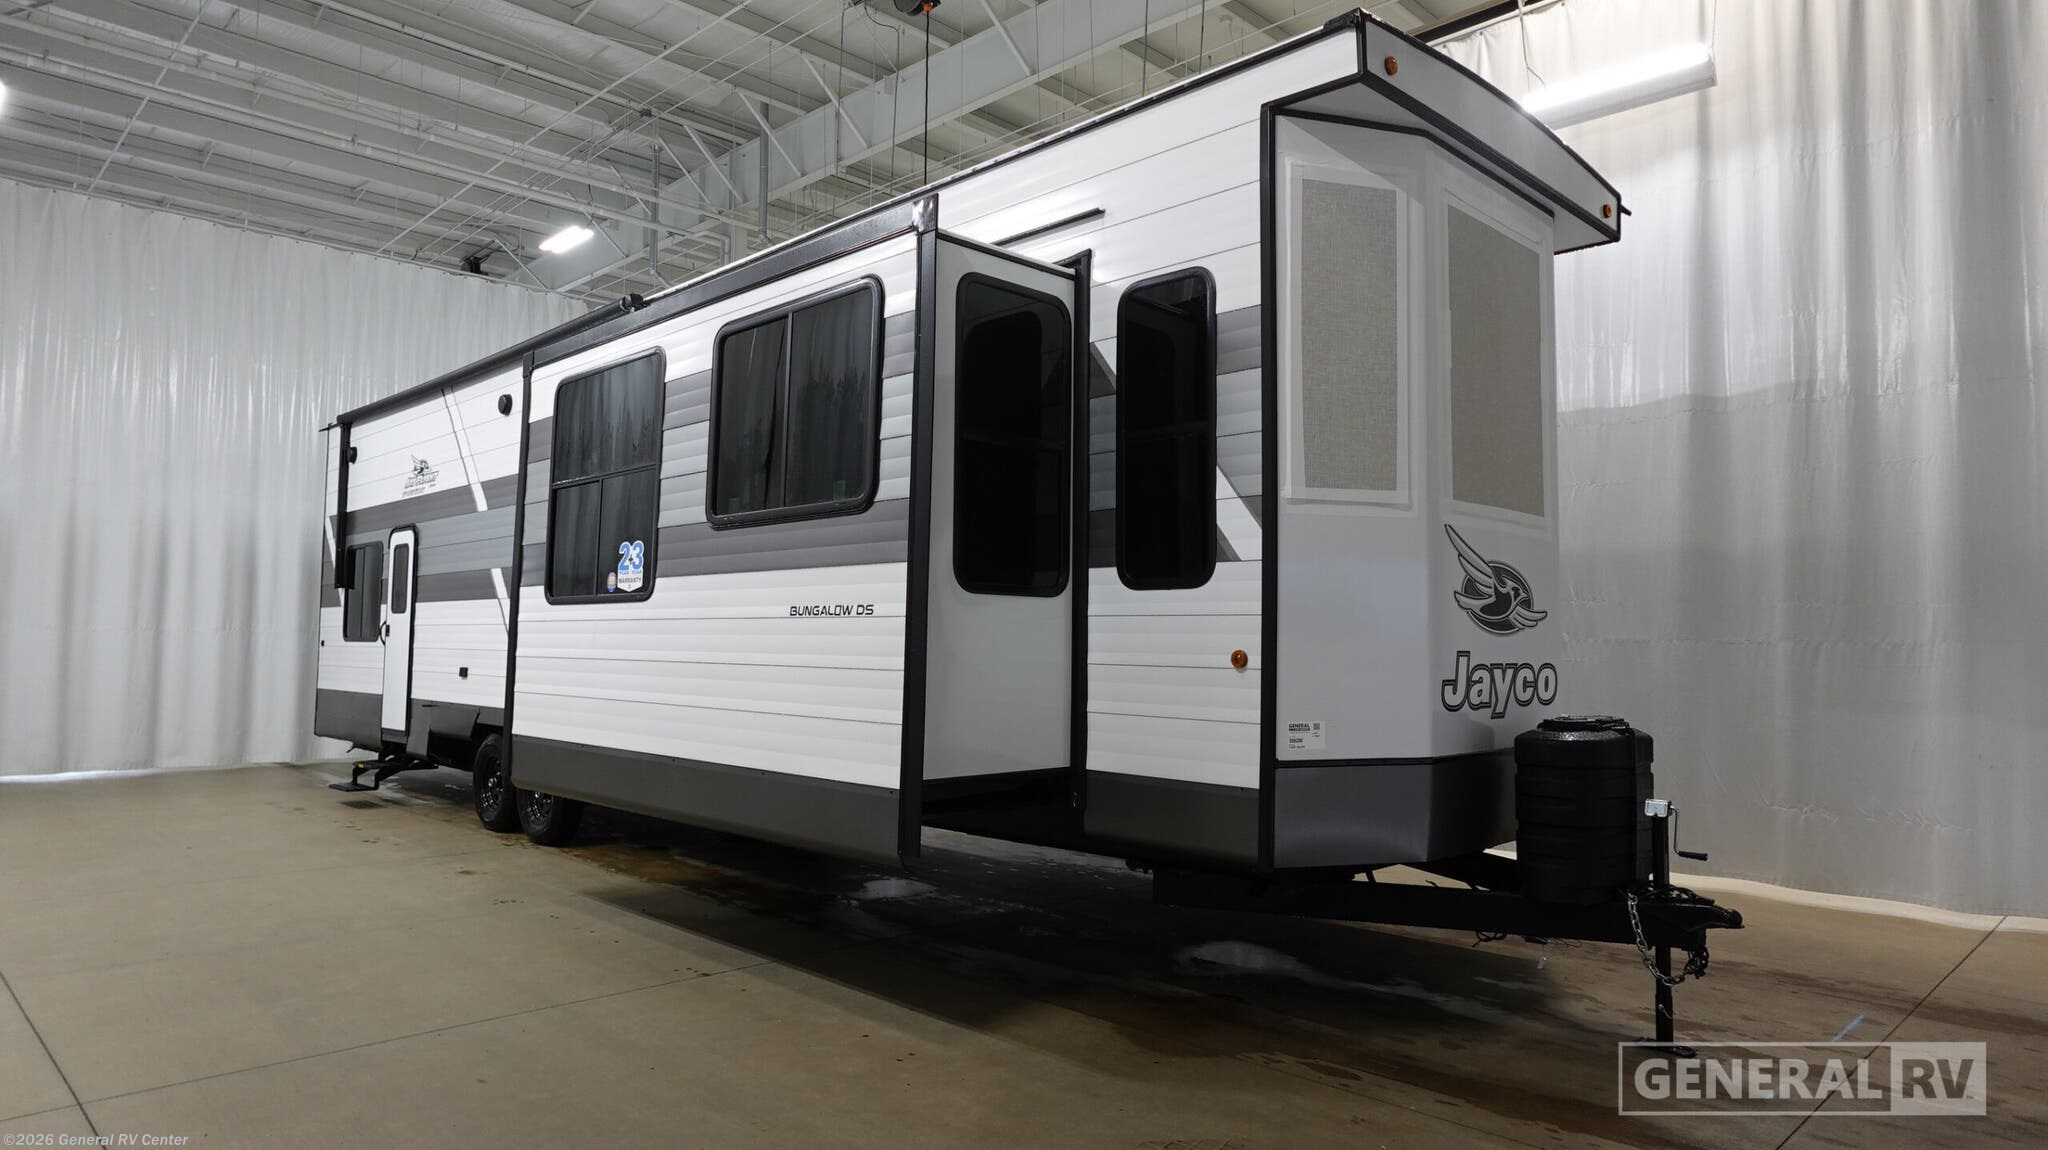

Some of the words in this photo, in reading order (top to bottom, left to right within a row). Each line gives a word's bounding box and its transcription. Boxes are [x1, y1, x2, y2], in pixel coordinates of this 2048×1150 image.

[619, 541, 644, 570] 23
[789, 604, 853, 616] BUNGALOW
[856, 604, 874, 616] DS
[1441, 650, 1558, 719] Jayco
